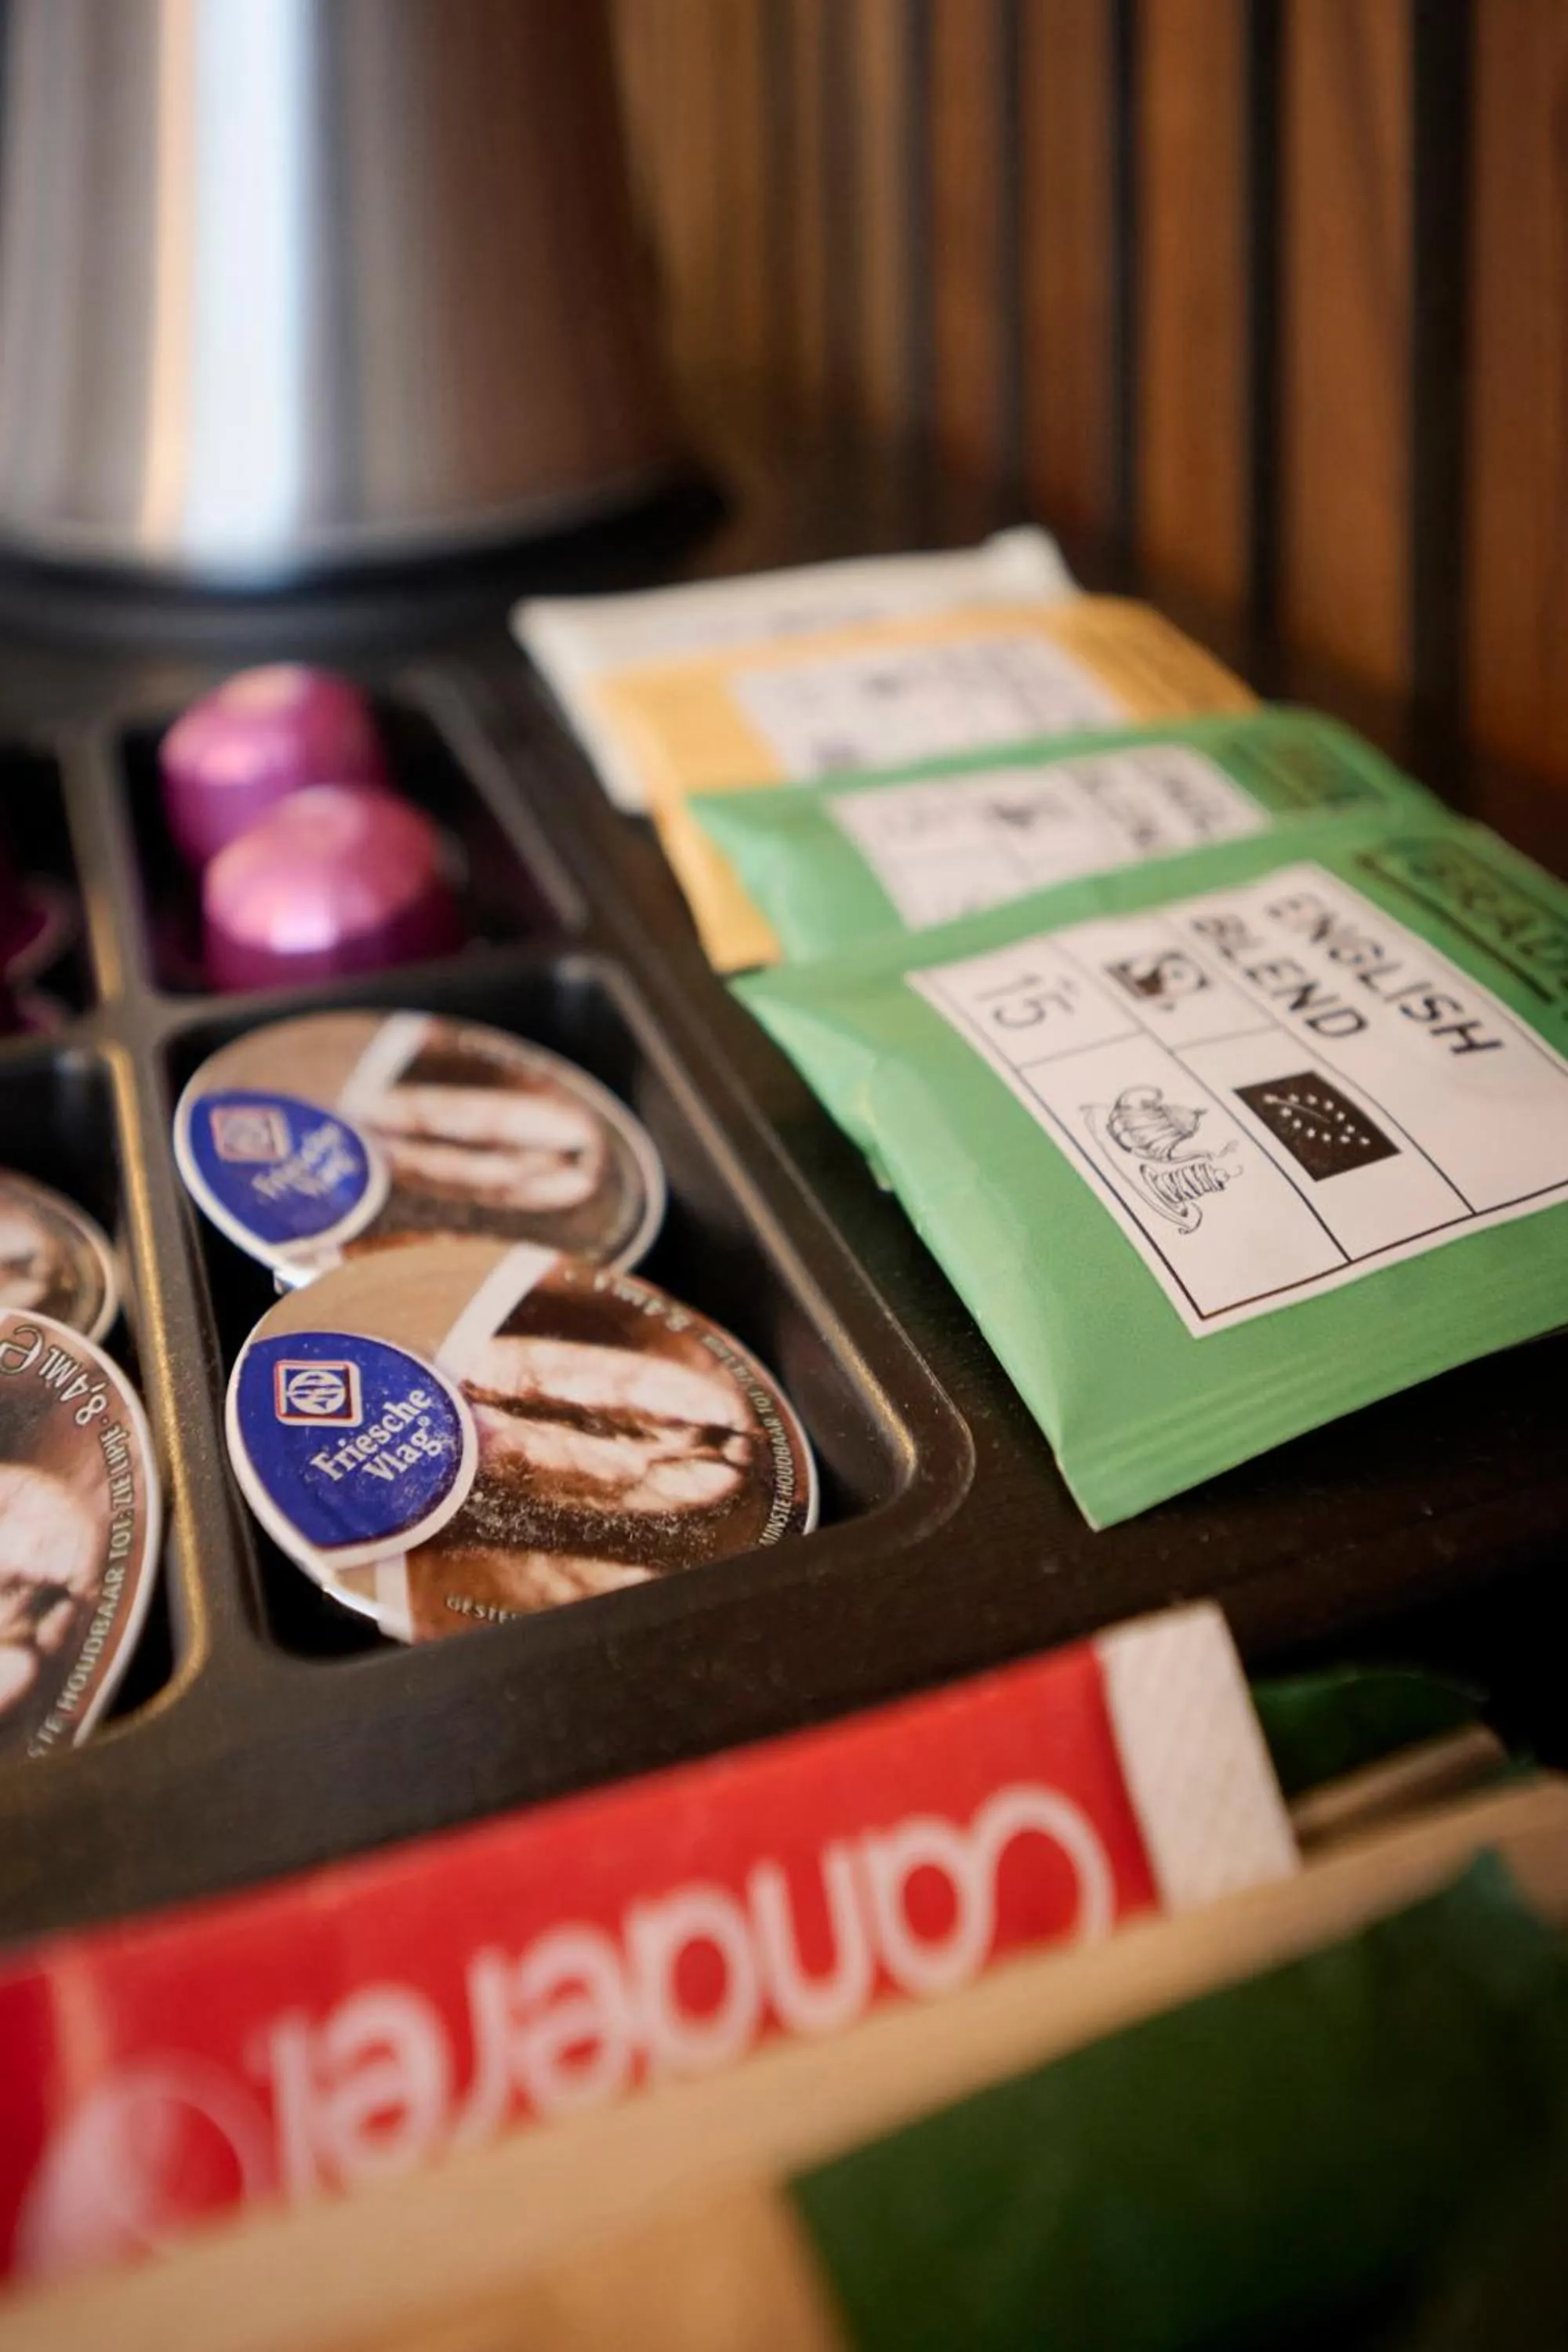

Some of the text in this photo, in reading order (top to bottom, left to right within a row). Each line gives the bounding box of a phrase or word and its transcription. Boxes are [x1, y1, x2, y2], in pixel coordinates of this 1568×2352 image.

[1189, 913, 1369, 1040] BLEND
[1265, 892, 1504, 1057] ENGLISH
[39, 1345, 81, 1389] ML
[60, 1372, 107, 1426] 8,4
[100, 1424, 129, 1475] LIPJE
[310, 1388, 433, 1482] Friesche
[763, 1416, 795, 1496] HOUDBAAR
[111, 1473, 133, 1508] ZIE
[56, 1567, 126, 1712] HOUDBAAR
